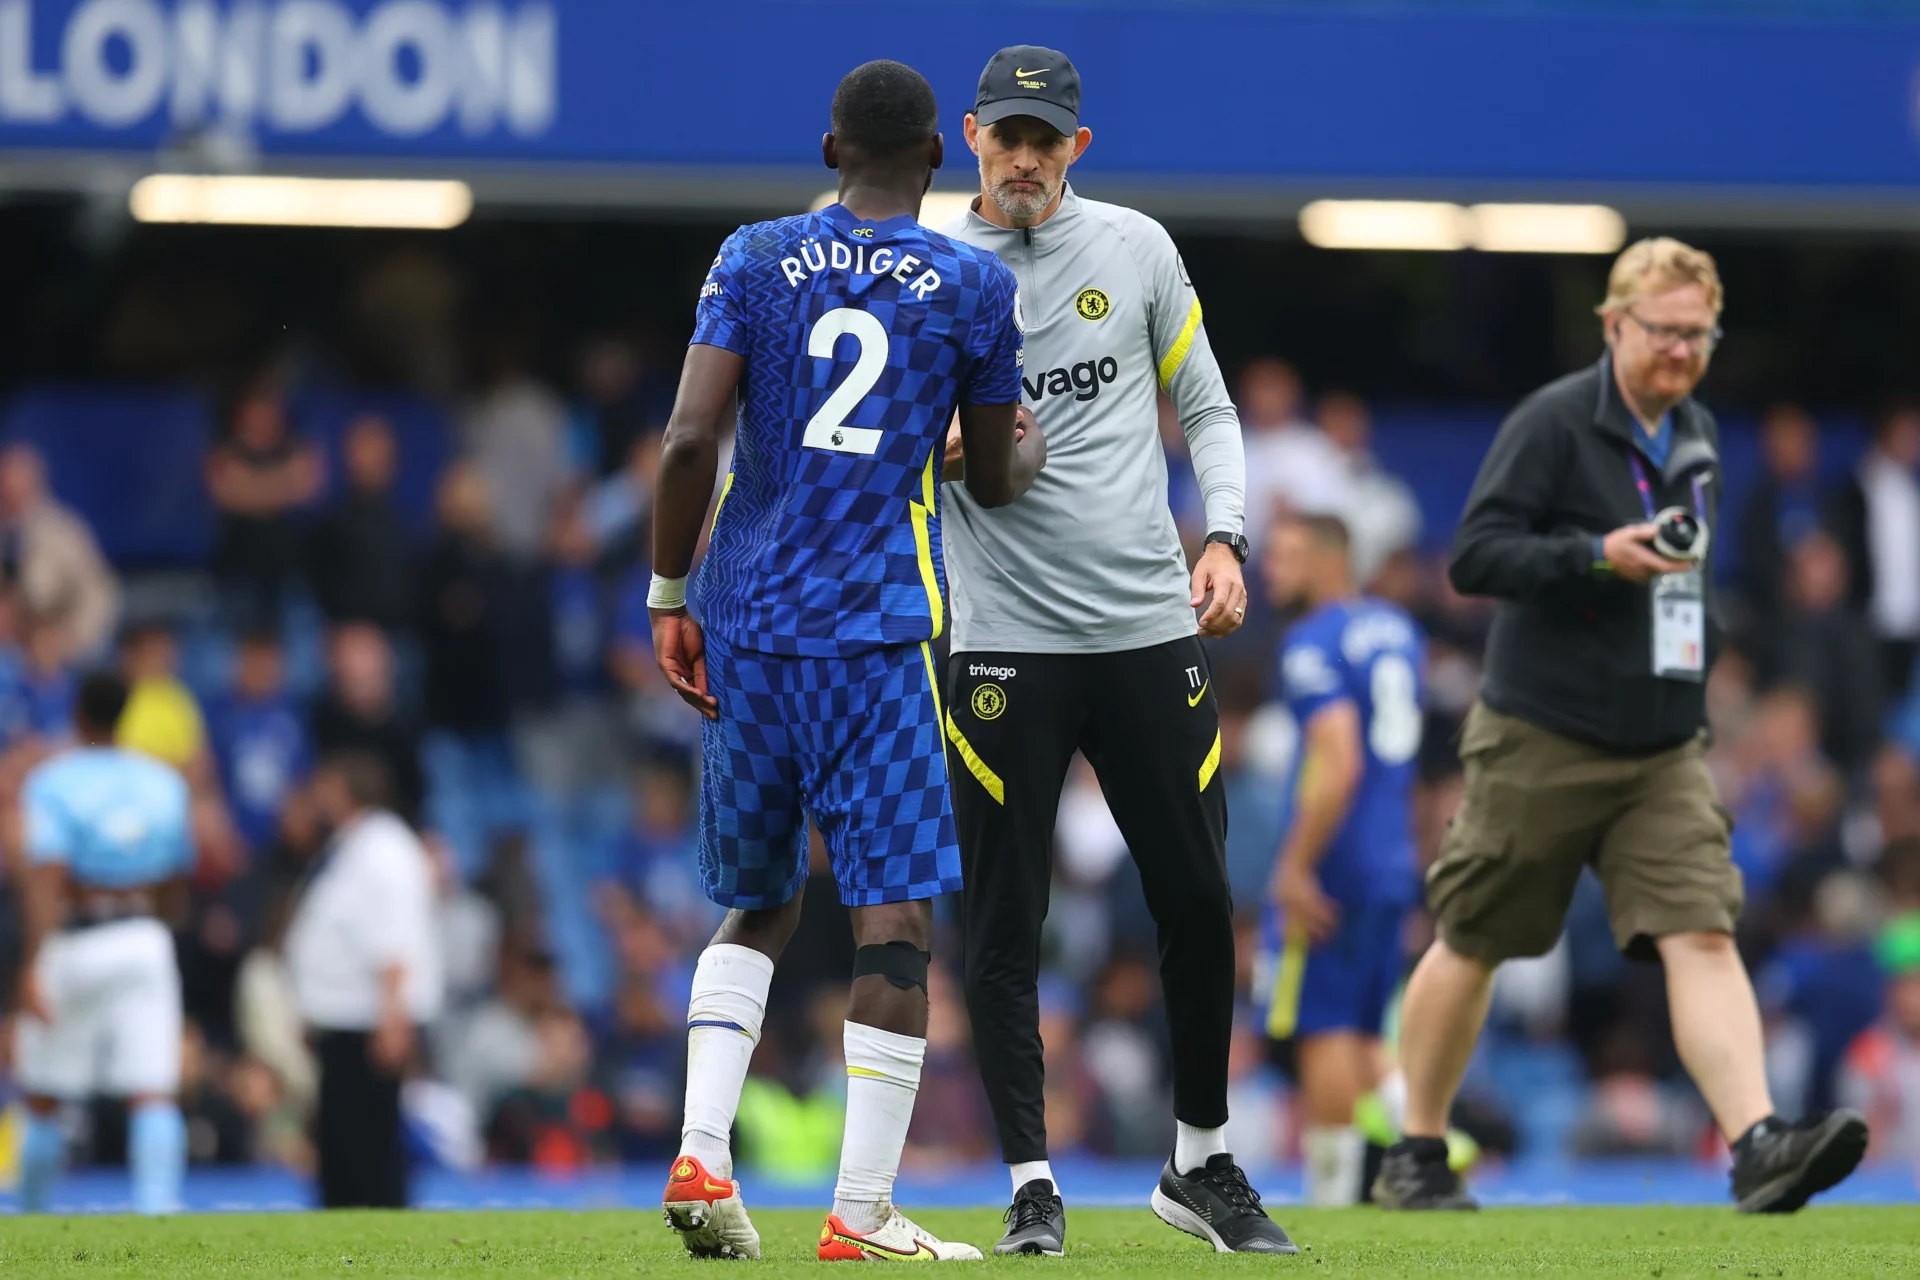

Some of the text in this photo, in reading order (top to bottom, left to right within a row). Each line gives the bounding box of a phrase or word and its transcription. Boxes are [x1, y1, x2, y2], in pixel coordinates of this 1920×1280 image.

[0, 0, 558, 137] LONDON
[852, 228, 874, 238] CFC
[780, 237, 942, 300] RÜDIGER
[1080, 290, 1102, 299] CHELSEA
[802, 307, 889, 455] 2
[1018, 356, 1118, 404] vago
[968, 663, 1016, 680] trivago
